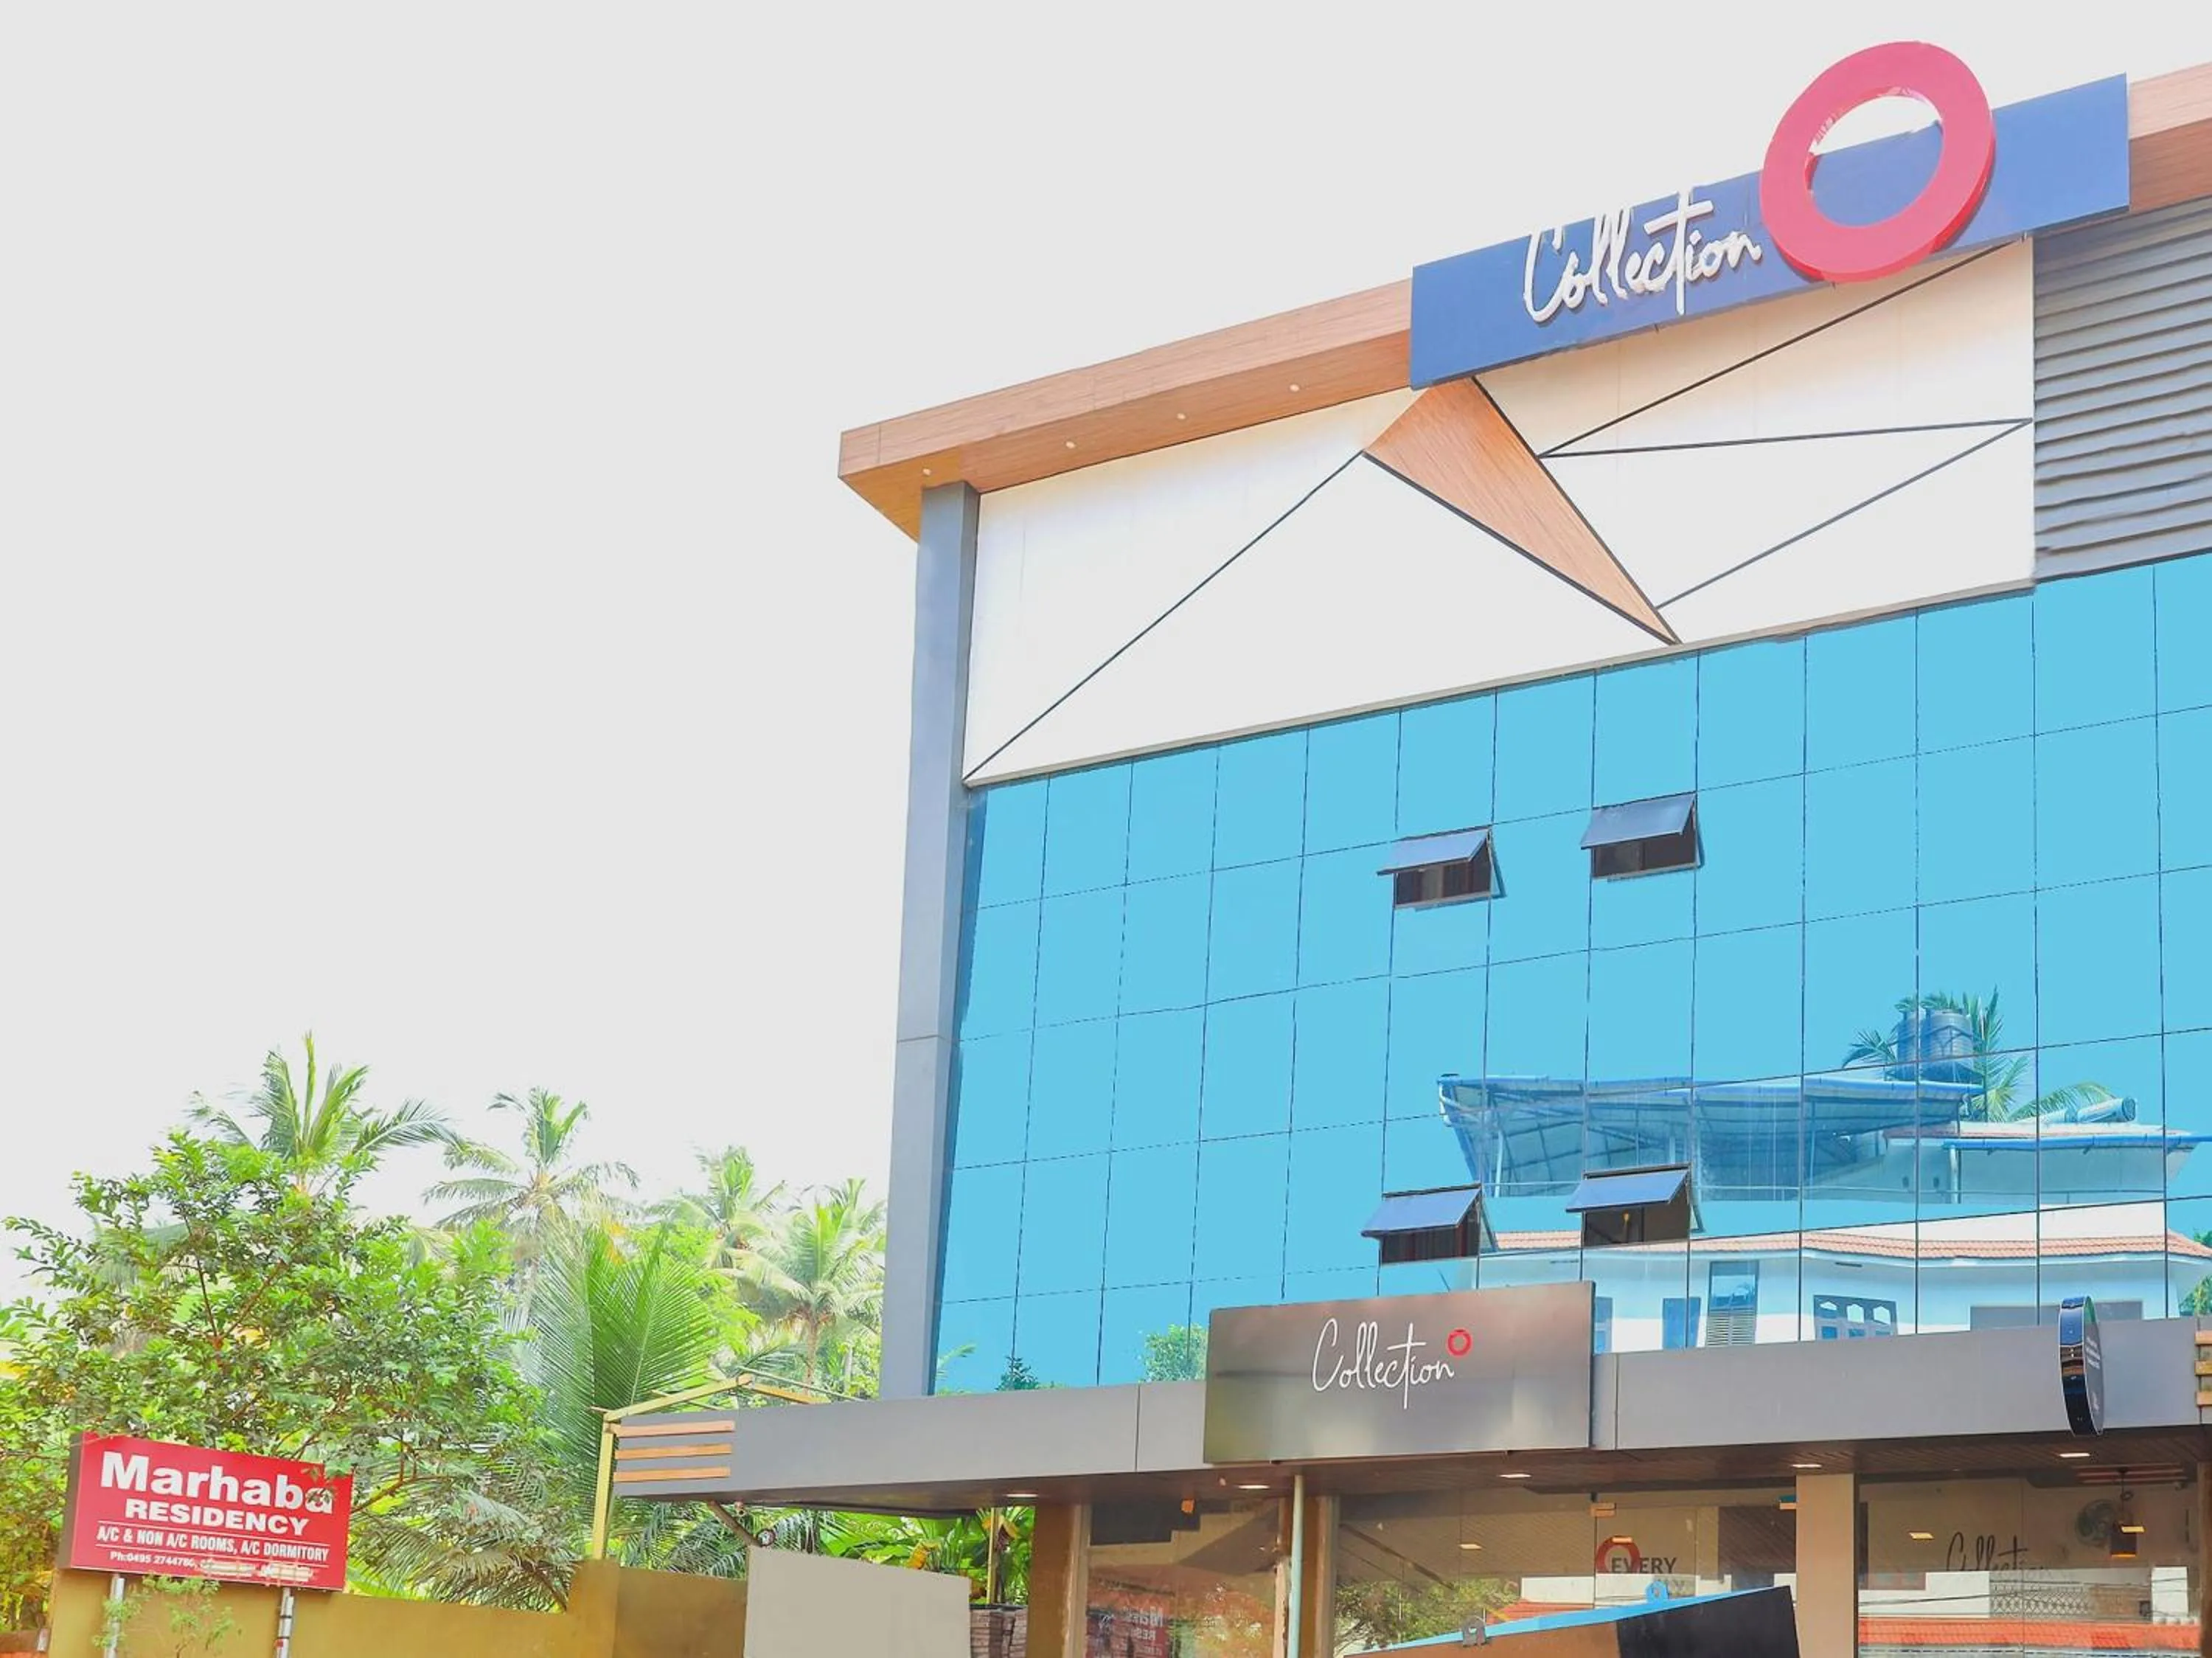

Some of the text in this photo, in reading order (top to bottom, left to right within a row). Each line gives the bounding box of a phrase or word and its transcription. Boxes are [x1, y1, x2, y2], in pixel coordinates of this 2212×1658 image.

[1523, 188, 1763, 322] Collection
[1312, 1317, 1455, 1409] Collection
[100, 1451, 334, 1515] Marhaba
[125, 1498, 310, 1536] RESIDENCY
[97, 1525, 330, 1561] A/C & NON A/C ROOMS, A/C DORMITORY
[1611, 1557, 1677, 1574] EVERY
